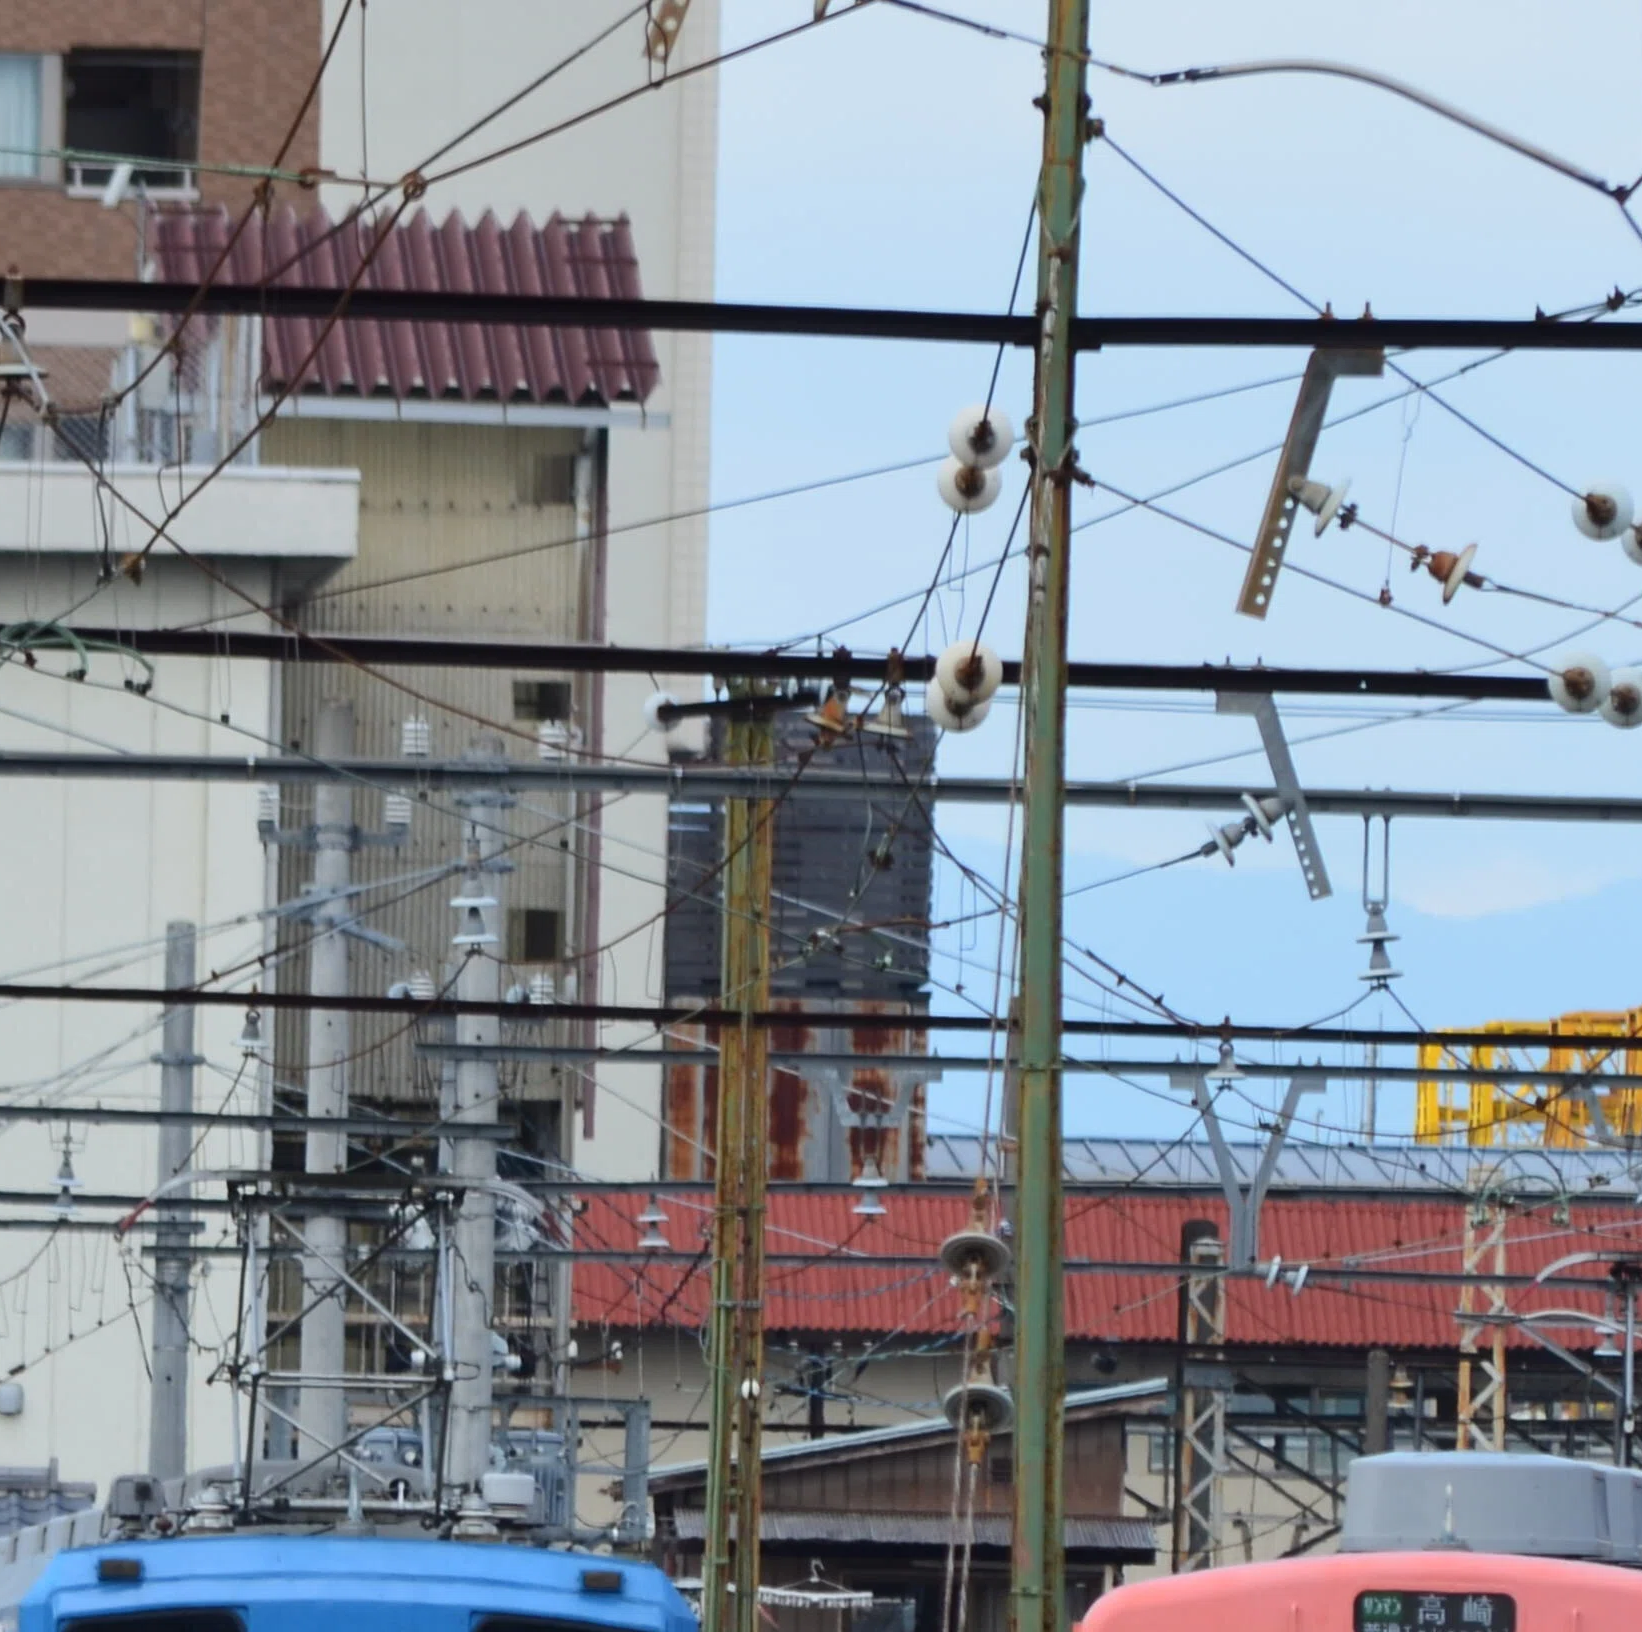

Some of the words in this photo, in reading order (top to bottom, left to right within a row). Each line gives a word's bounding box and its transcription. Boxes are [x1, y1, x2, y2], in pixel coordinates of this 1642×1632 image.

[1363, 1596, 1402, 1615] ワンマン
[1418, 1594, 1493, 1626] 高崎
